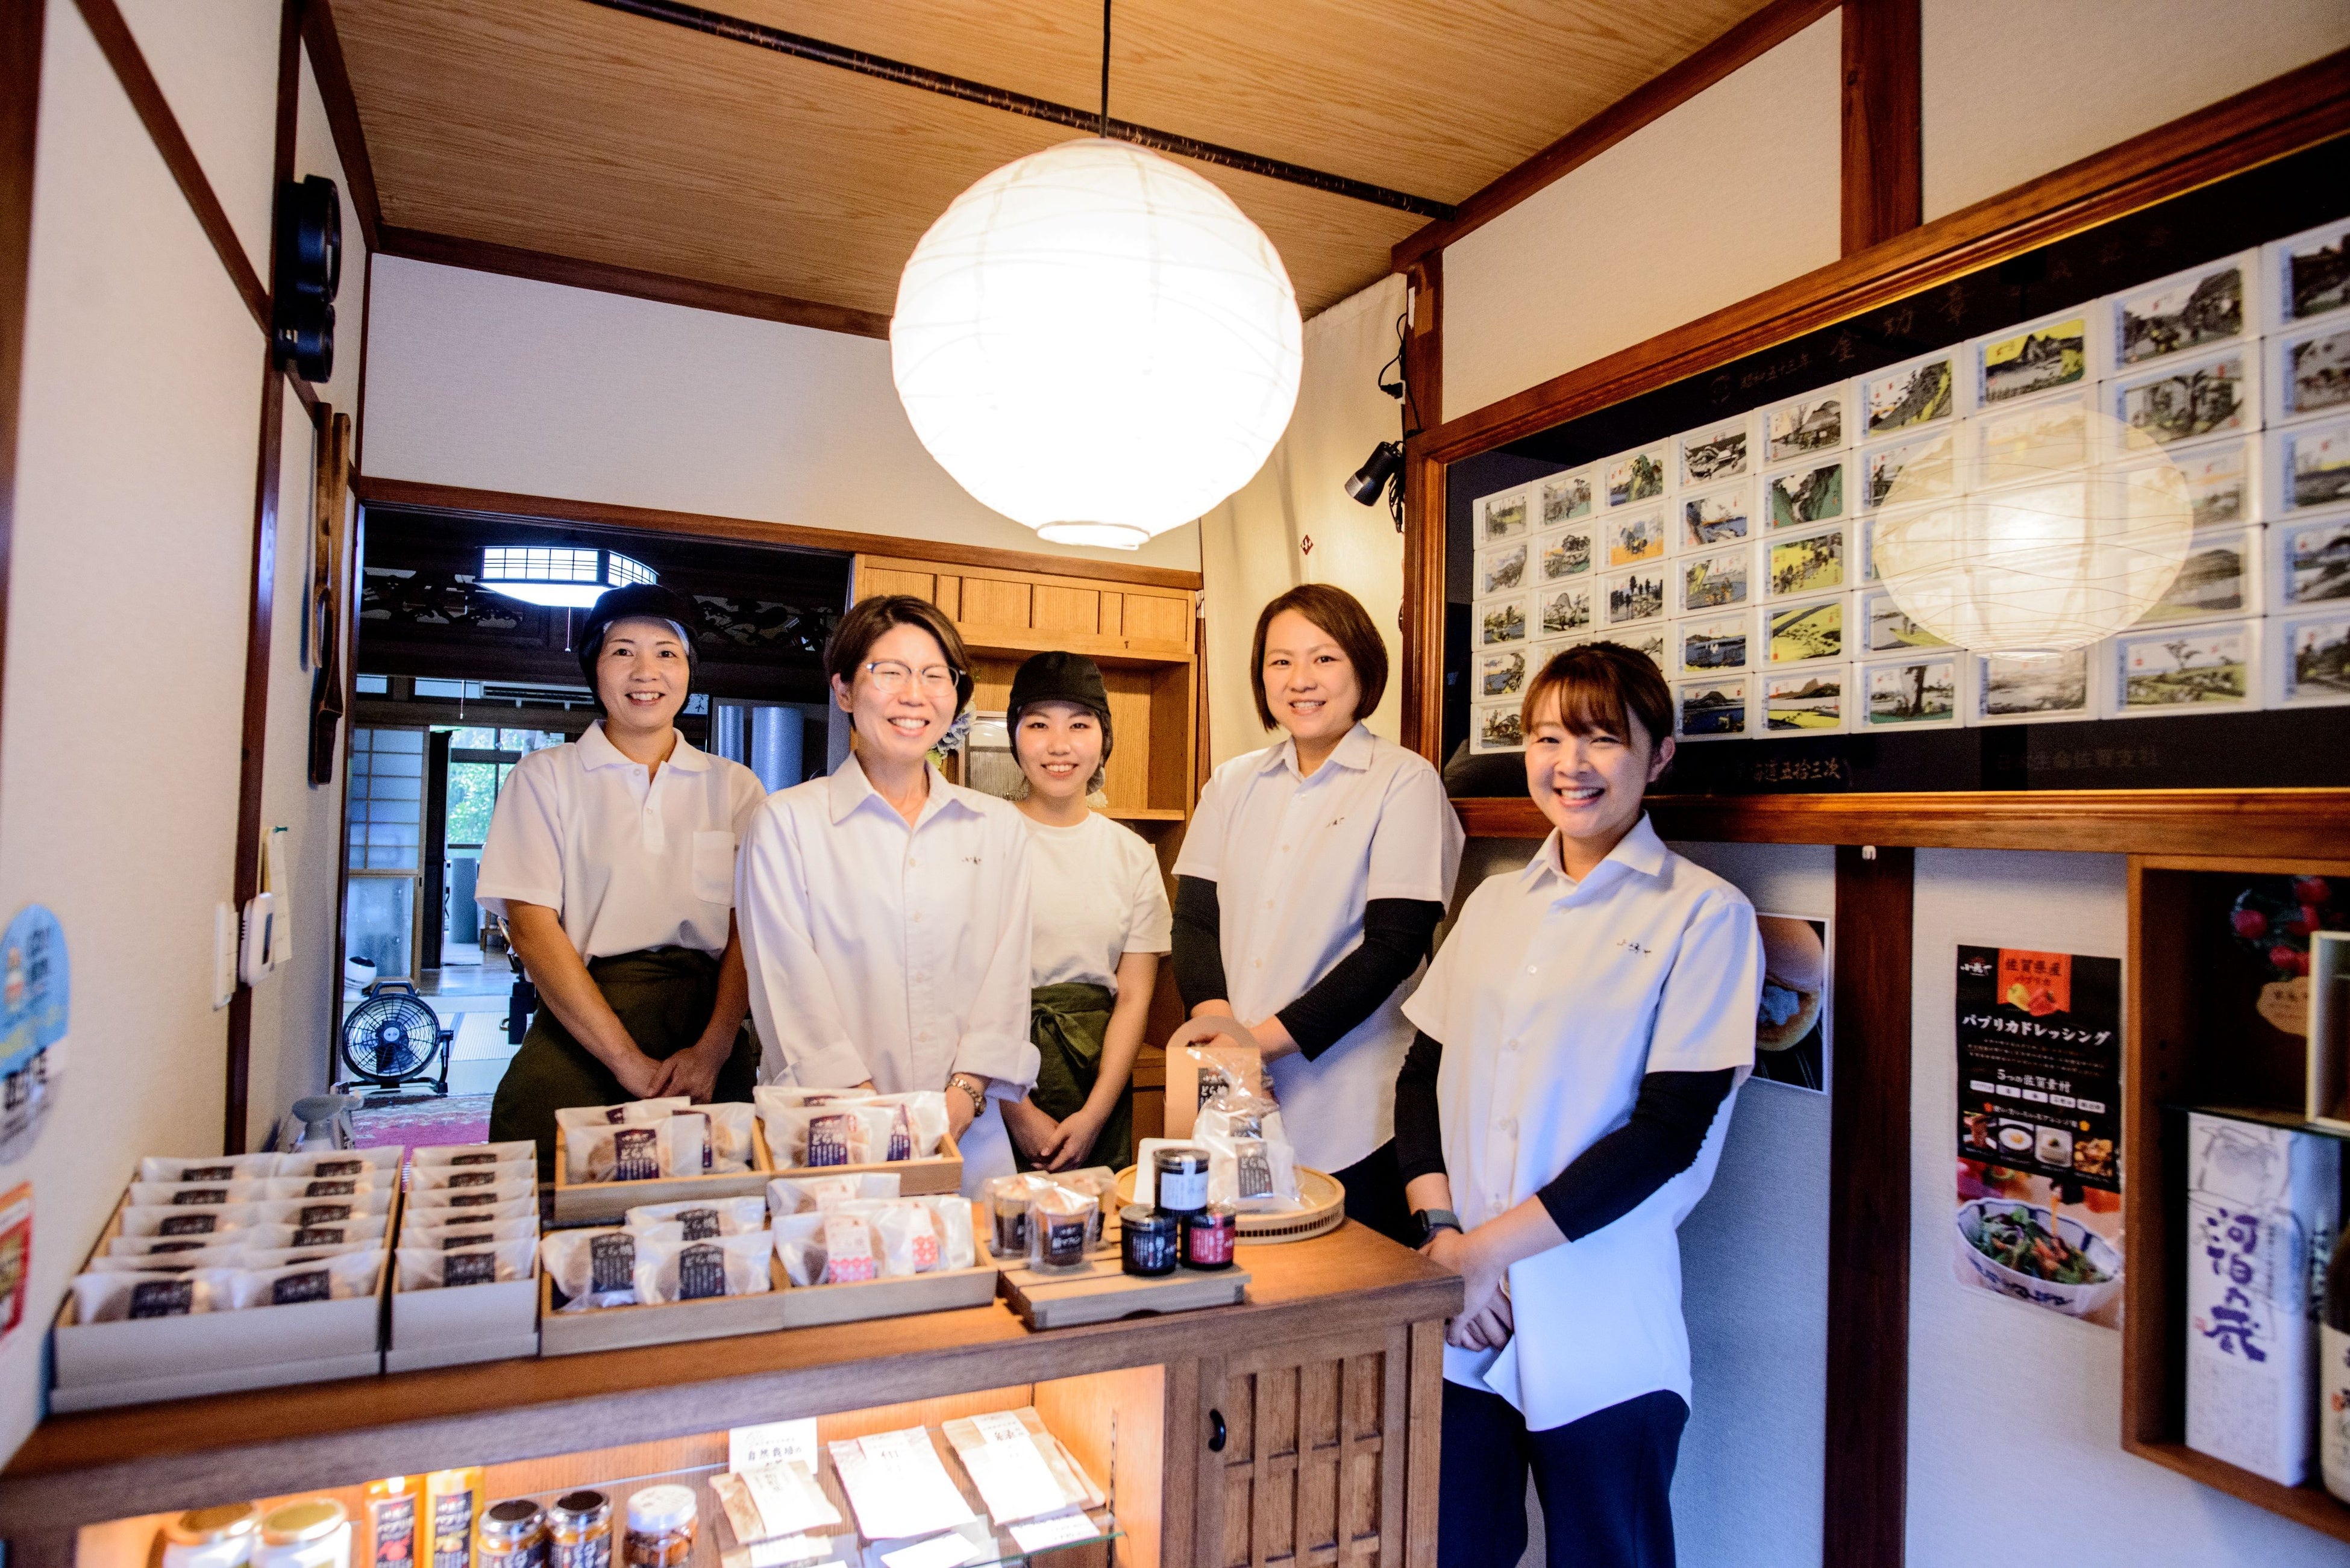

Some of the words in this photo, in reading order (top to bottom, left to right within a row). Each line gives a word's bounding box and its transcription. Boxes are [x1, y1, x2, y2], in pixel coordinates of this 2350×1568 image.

[2005, 958, 2061, 976] 佐賀県産
[1961, 1013, 2111, 1046] パプリカドレッシング
[748, 1445, 803, 1461] 自然栽培の
